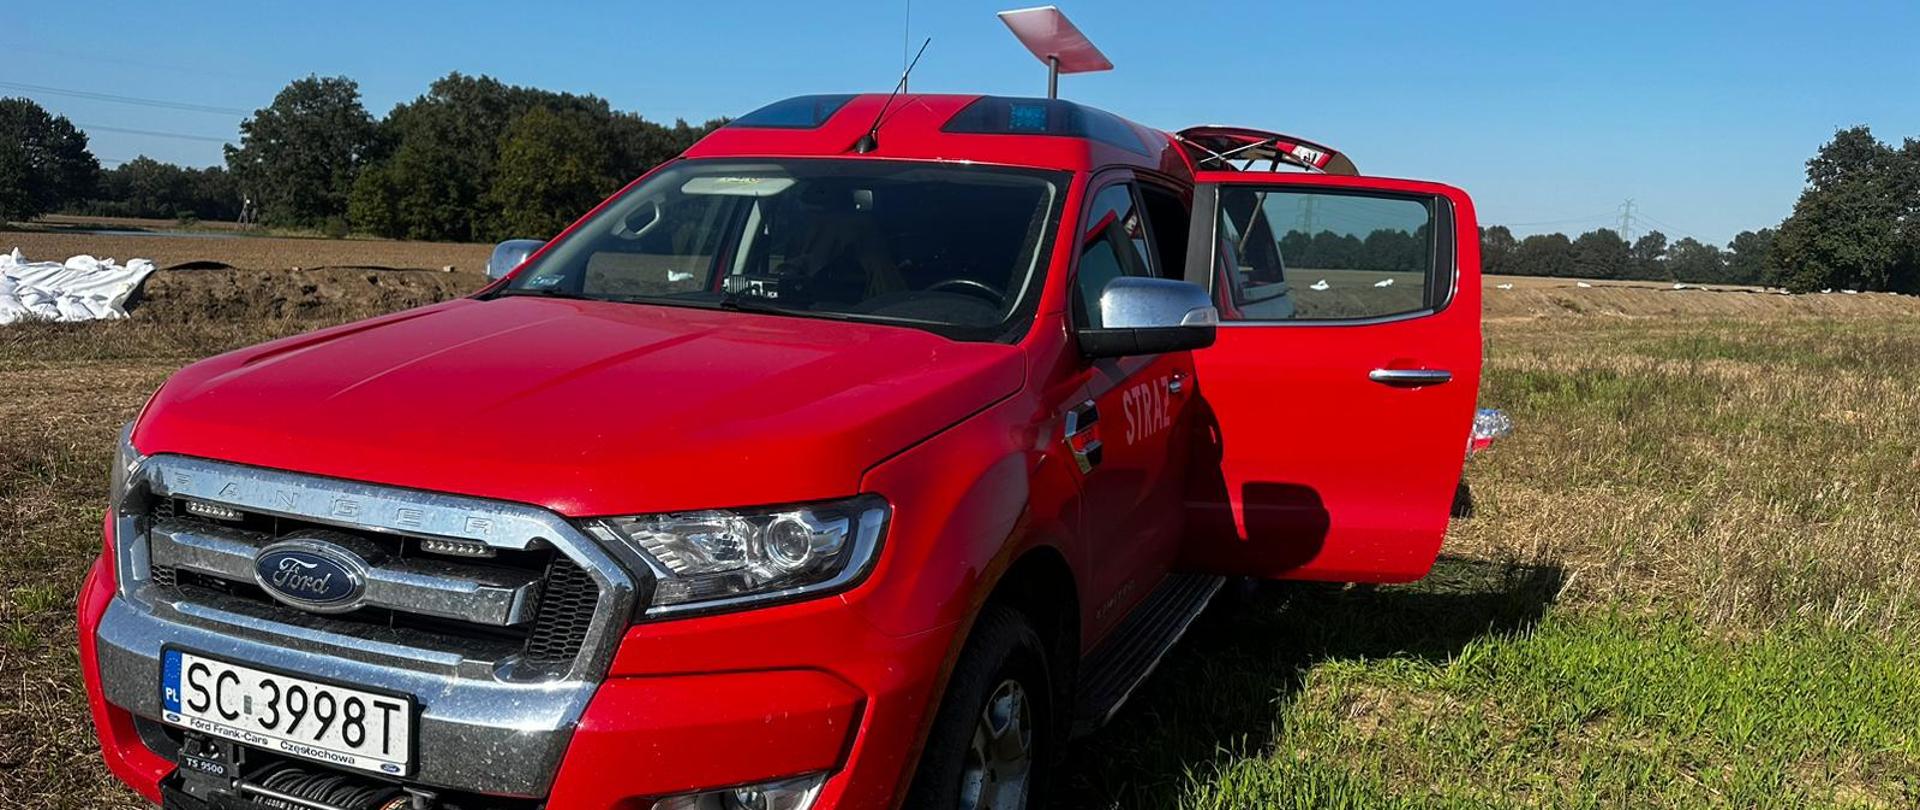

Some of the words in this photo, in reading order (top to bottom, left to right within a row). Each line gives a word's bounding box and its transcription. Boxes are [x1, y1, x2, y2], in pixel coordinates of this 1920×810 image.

[174, 472, 491, 534] RANGER
[273, 557, 332, 594] Ford
[165, 686, 179, 704] PL
[257, 679, 401, 754] 3998T
[189, 717, 211, 733] Ford
[213, 723, 269, 746] Frank-Cars
[280, 740, 356, 765] Częstochowa
[186, 757, 199, 768] TS
